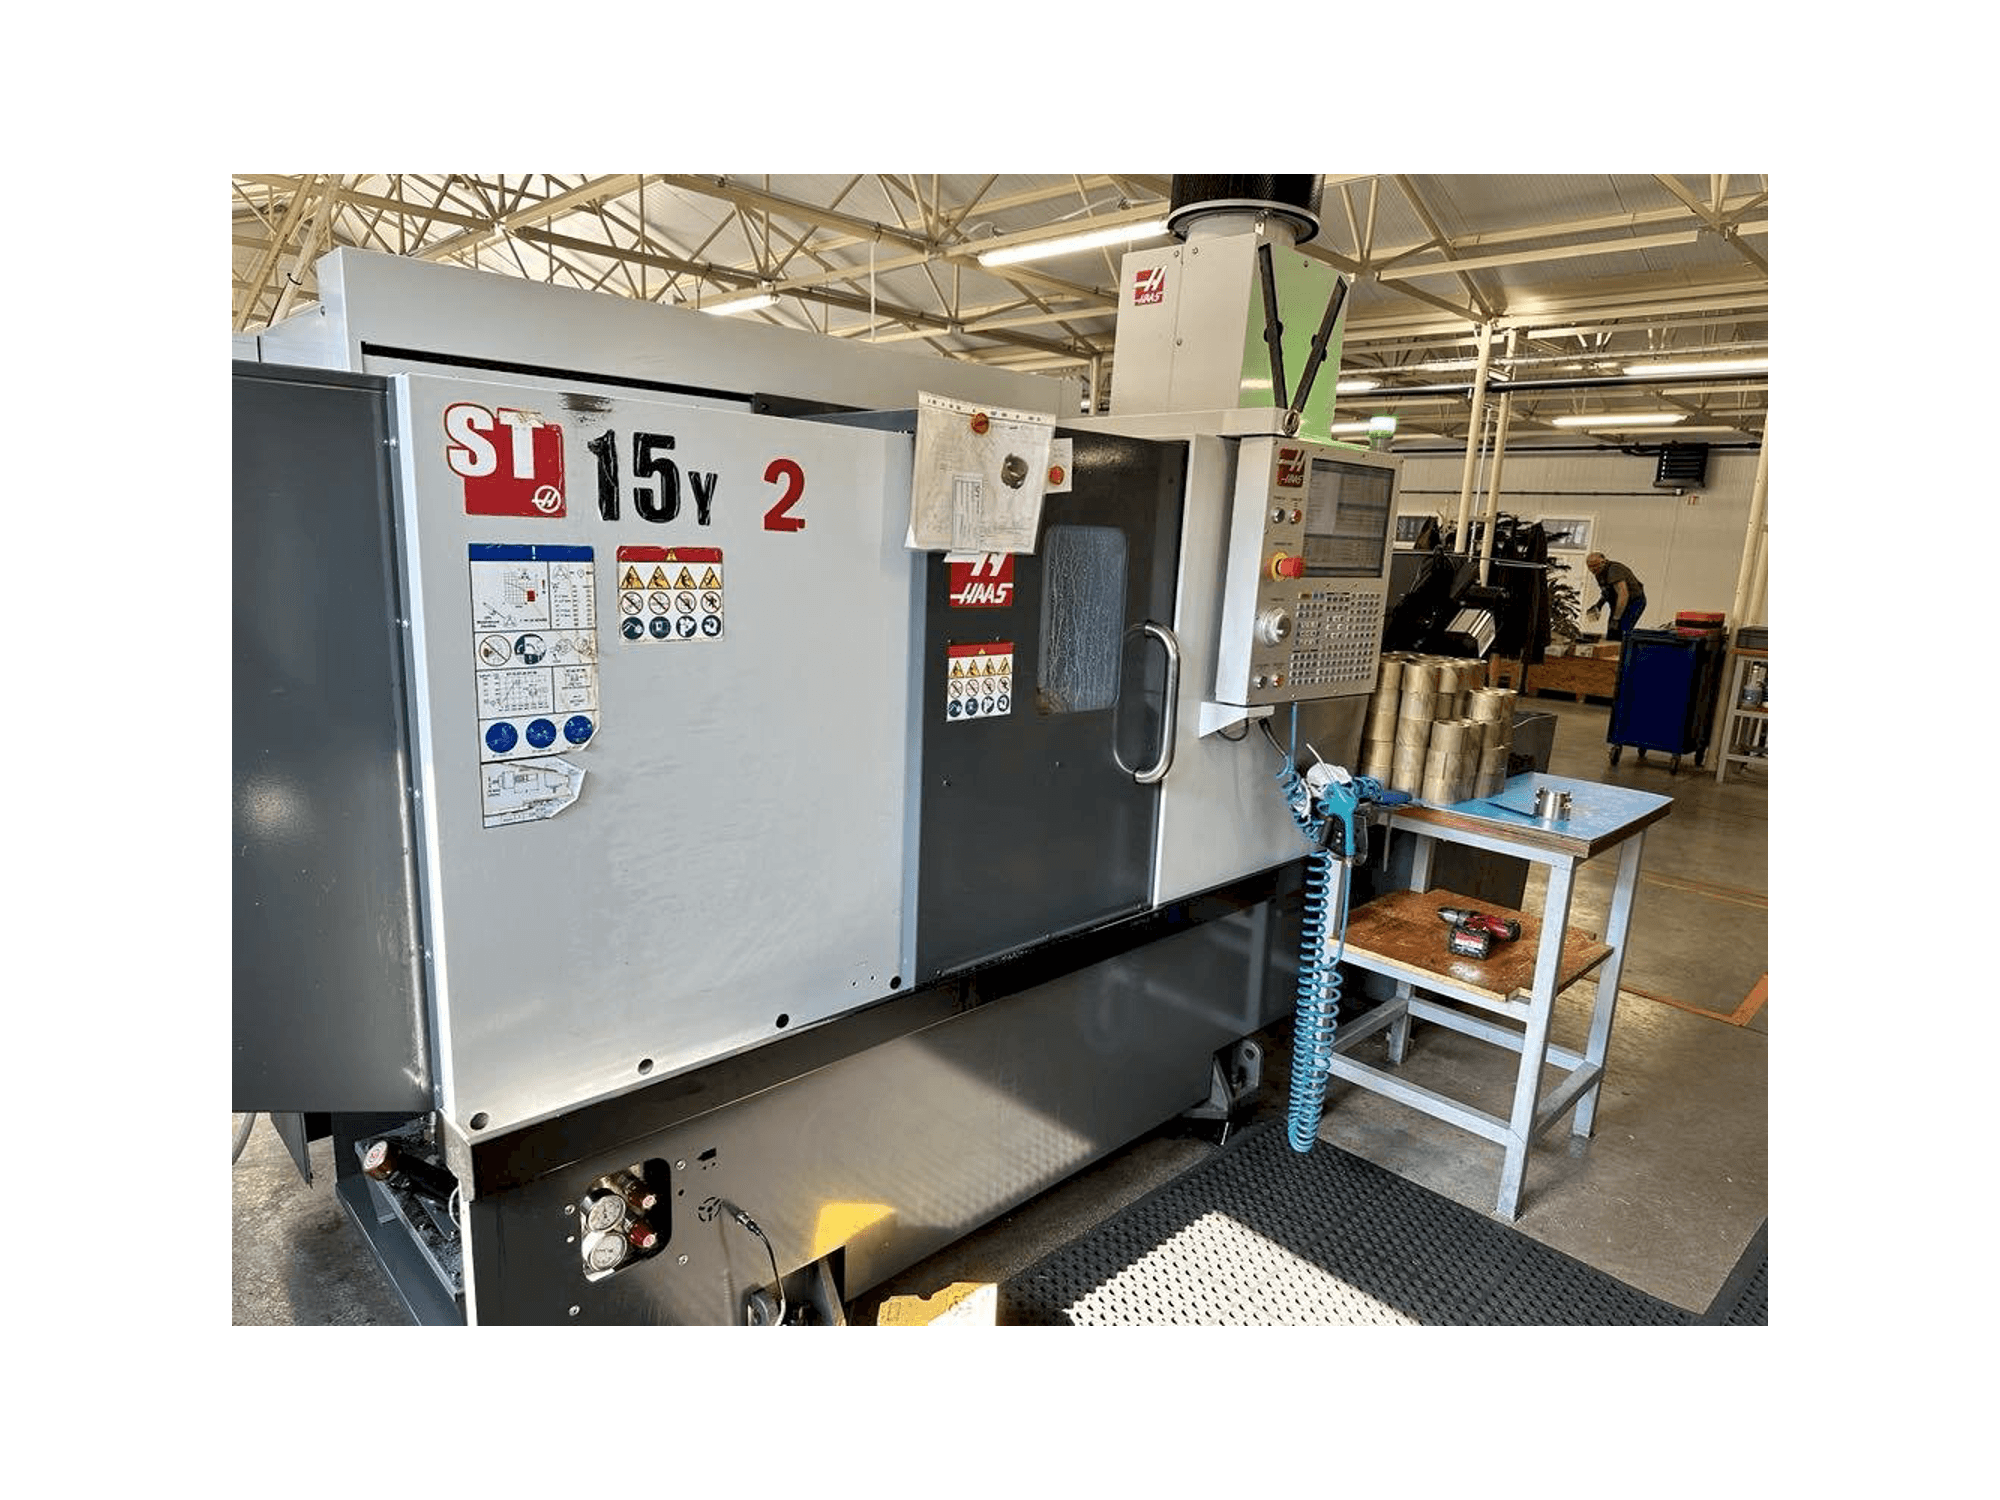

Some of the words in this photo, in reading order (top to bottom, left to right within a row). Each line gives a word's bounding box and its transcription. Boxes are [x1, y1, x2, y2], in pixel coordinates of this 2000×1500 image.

[1134, 292, 1163, 304] HAAS
[444, 402, 546, 480] ST
[763, 458, 805, 532] 2
[950, 582, 1014, 605] HAAS
